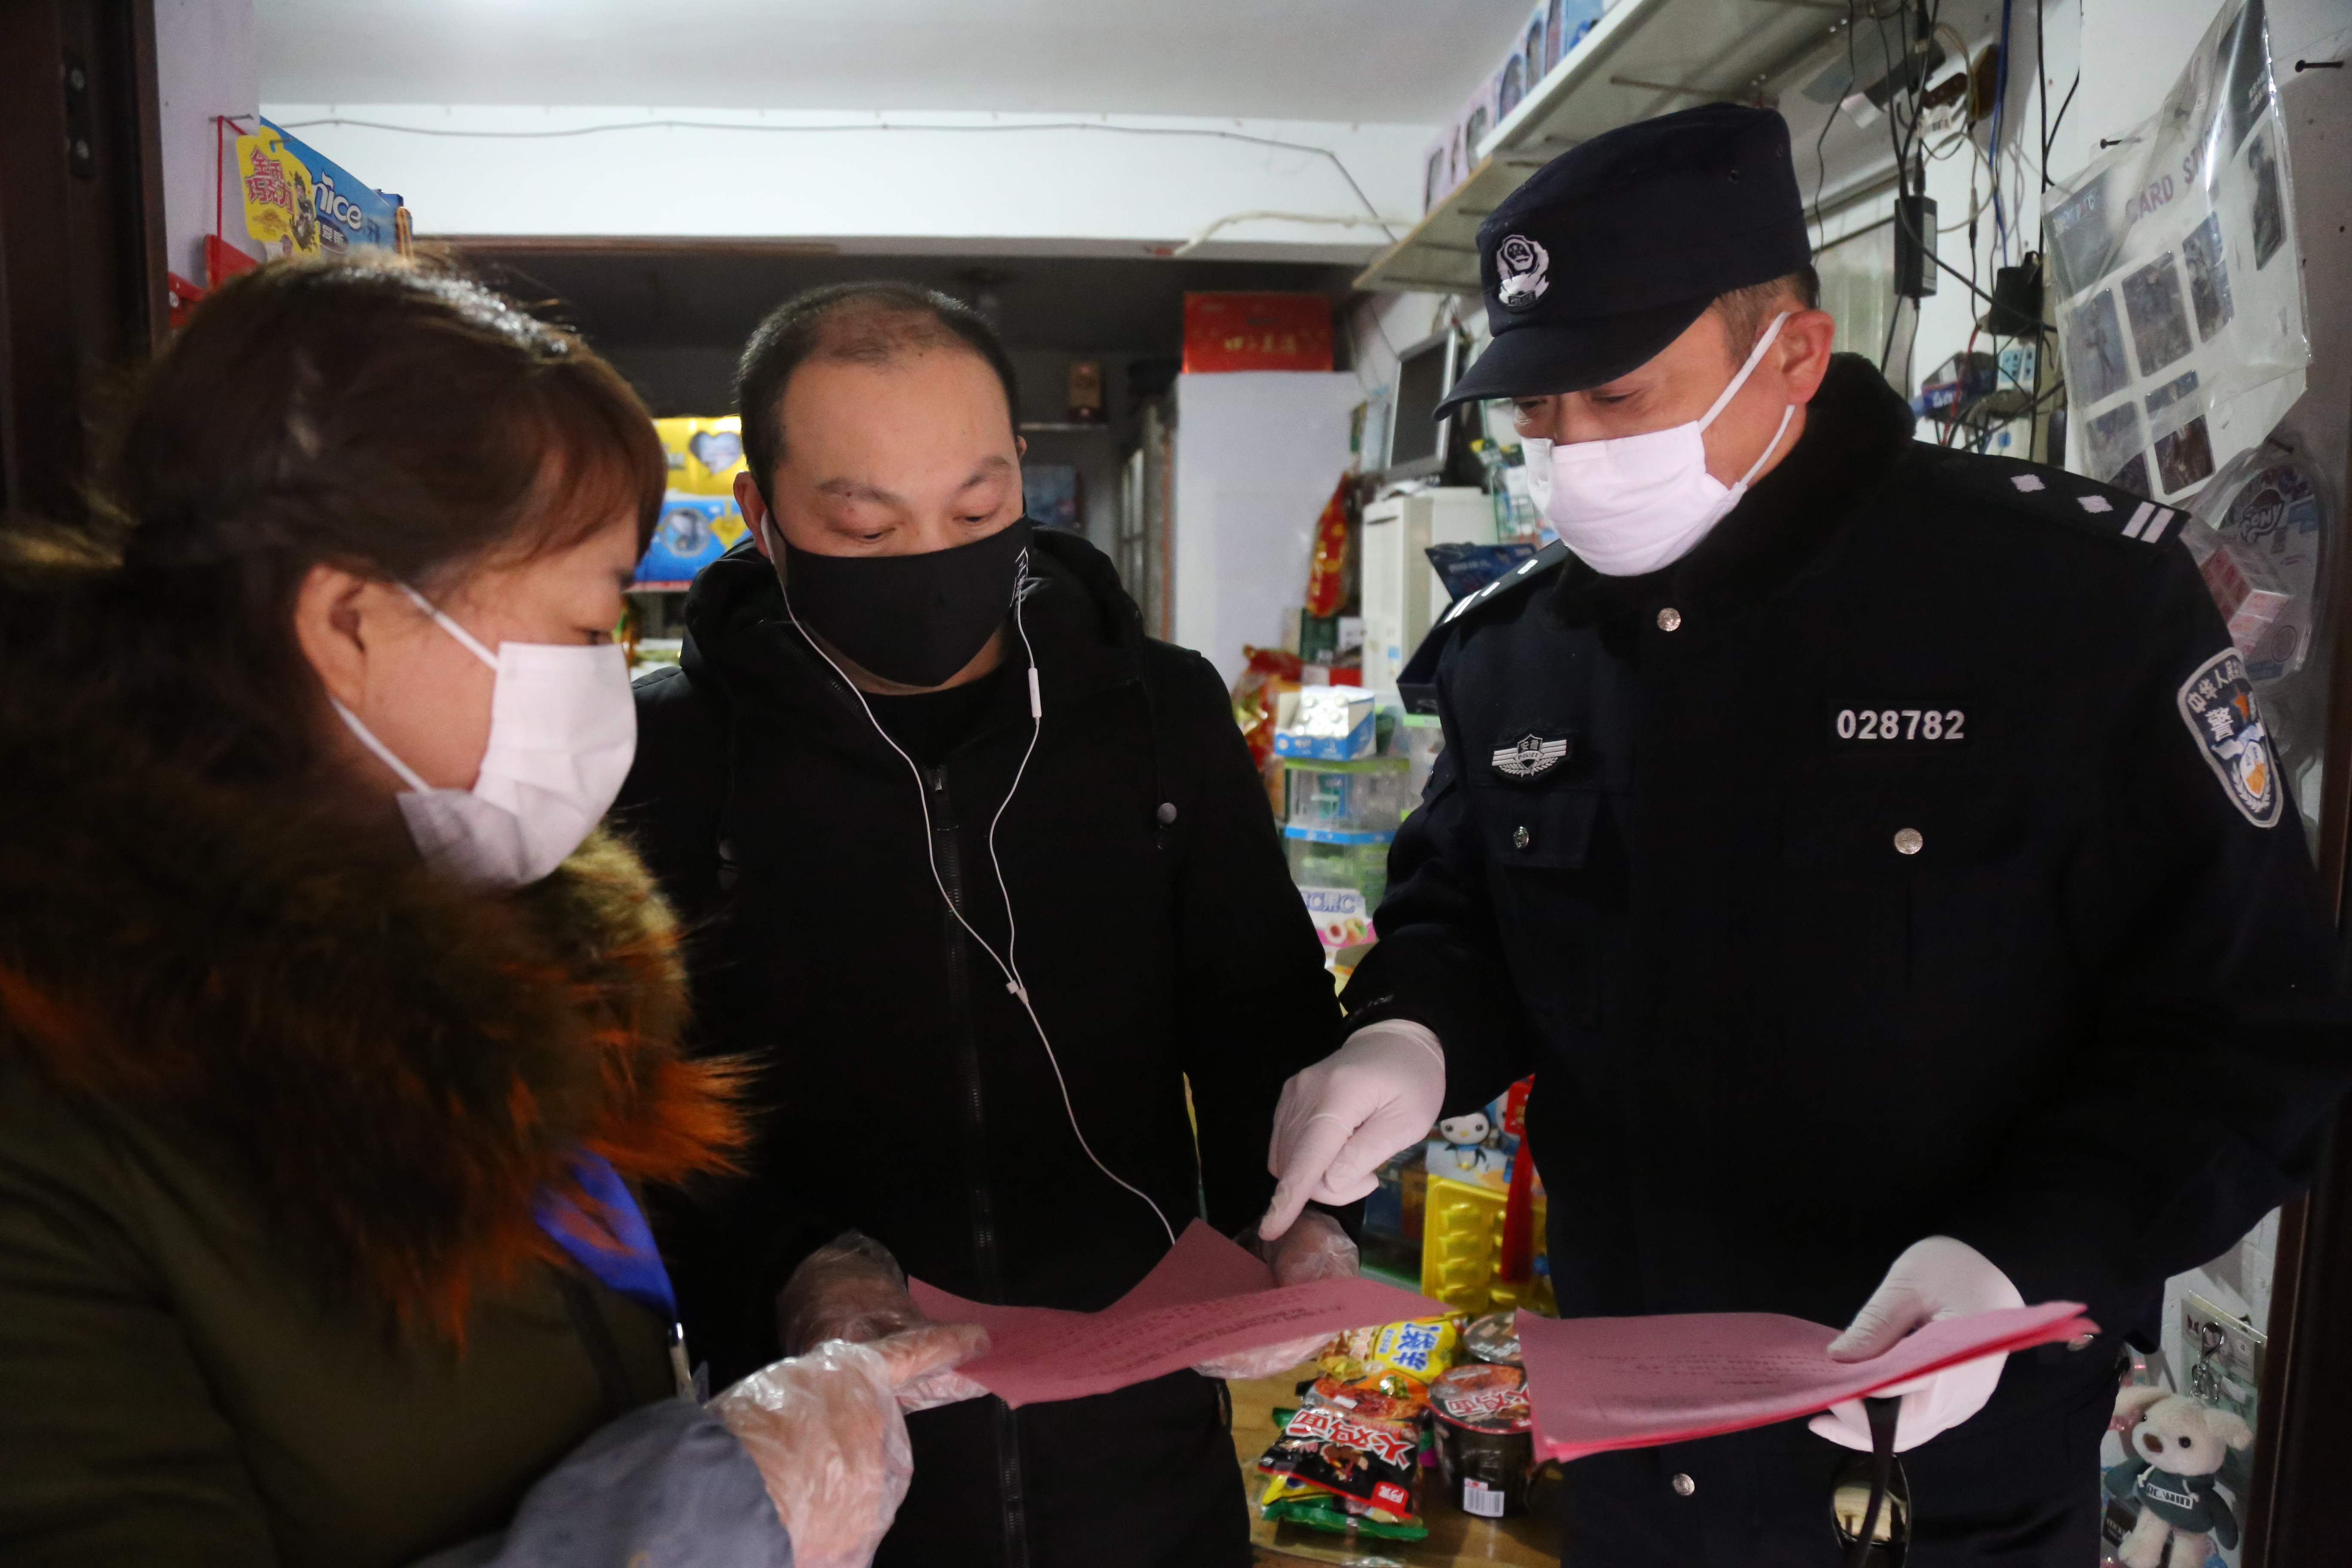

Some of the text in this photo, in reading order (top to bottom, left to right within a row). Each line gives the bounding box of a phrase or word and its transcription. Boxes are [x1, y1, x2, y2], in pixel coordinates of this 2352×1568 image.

[1837, 709, 1965, 740] 028782
[1286, 1408, 1415, 1470] 火鸡面
